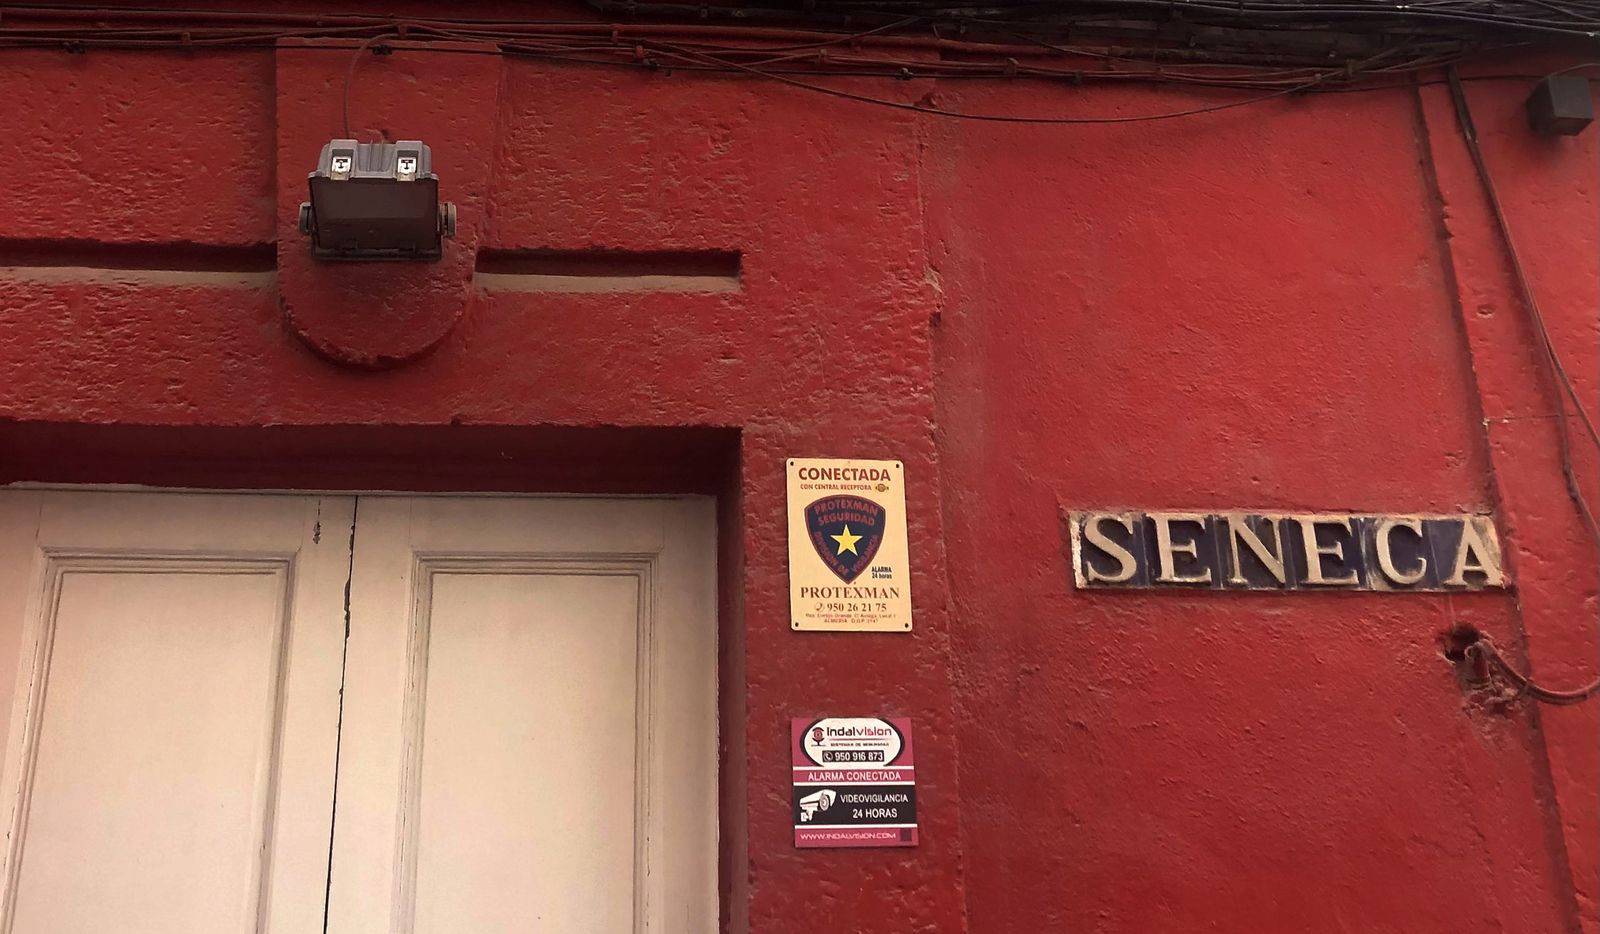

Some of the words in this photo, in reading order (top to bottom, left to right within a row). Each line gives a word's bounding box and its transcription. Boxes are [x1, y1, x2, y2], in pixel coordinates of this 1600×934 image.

[798, 467, 891, 481] CONECTADA
[814, 499, 879, 516] PROTEXMAN
[817, 512, 875, 527] SEGURIDAD
[1083, 513, 1503, 585] SENECA
[800, 587, 900, 599] PROTEXMAN
[827, 603, 844, 612] 950
[847, 603, 859, 612] 26
[861, 603, 872, 612] 21
[876, 603, 887, 612] 75
[835, 752, 850, 761] 950
[852, 752, 866, 761] 916
[868, 752, 883, 761] 873
[808, 772, 844, 781] ALARMA
[846, 771, 902, 781] CONECTADA
[840, 794, 909, 804] VIDEOVIGILANCIA
[852, 808, 863, 819] 24
[865, 808, 898, 819] HORAS
